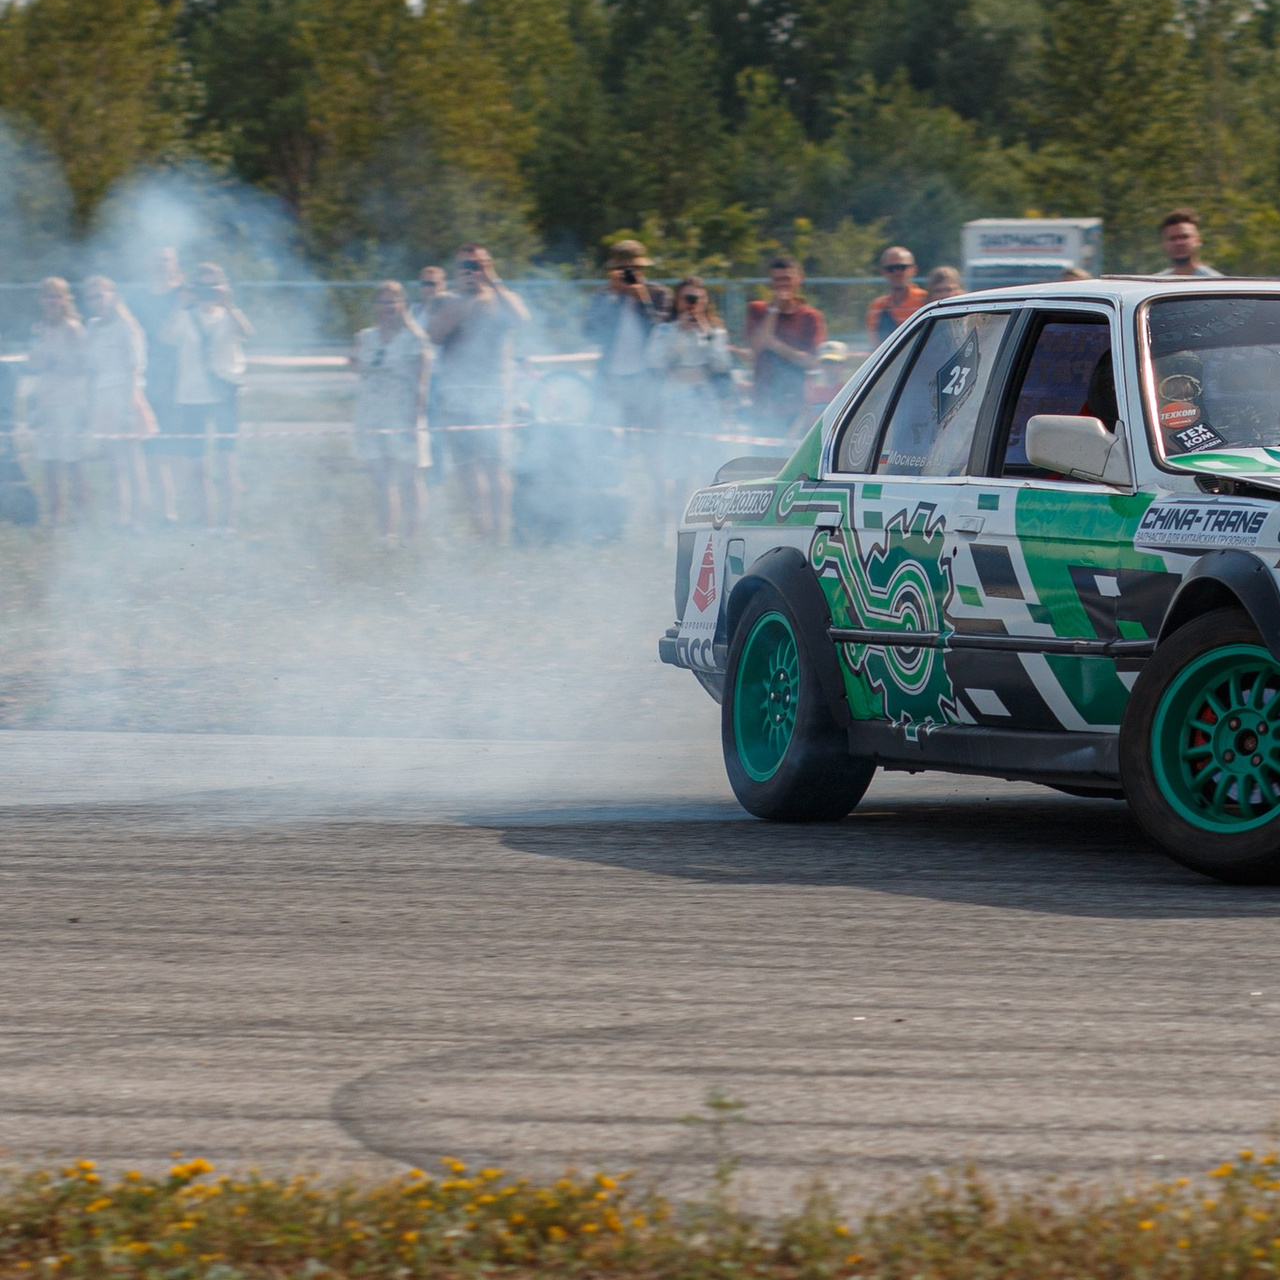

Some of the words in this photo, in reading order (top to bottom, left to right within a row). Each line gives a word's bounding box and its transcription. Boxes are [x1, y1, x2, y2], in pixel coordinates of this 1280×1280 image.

[942, 366, 971, 396] 23
[1176, 424, 1209, 441] ТЕХ
[1184, 431, 1215, 448] КОМ
[1140, 508, 1267, 534] CHINA-TRANS
